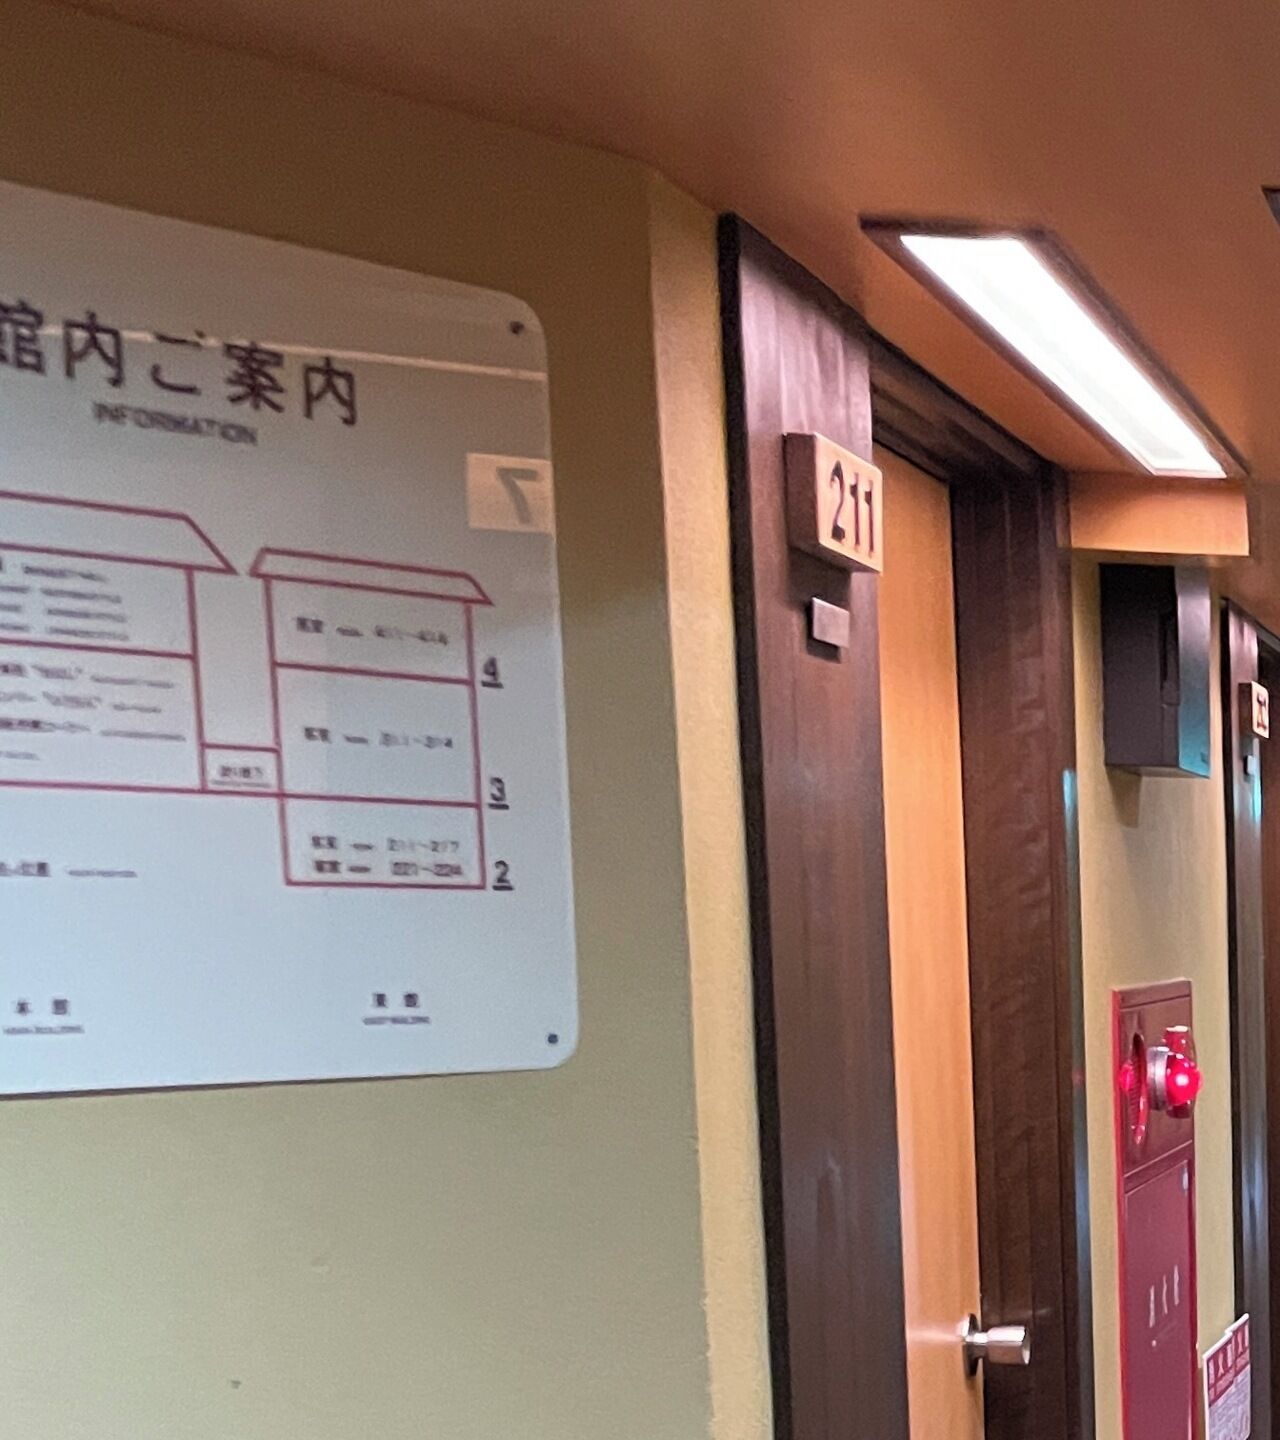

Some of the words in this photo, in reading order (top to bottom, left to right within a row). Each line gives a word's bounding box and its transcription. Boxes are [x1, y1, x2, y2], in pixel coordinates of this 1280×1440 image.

[92, 401, 257, 446] INFORMATION
[831, 460, 873, 557] 211
[483, 656, 499, 683] 4
[490, 776, 506, 802] 3
[494, 859, 510, 884] 2
